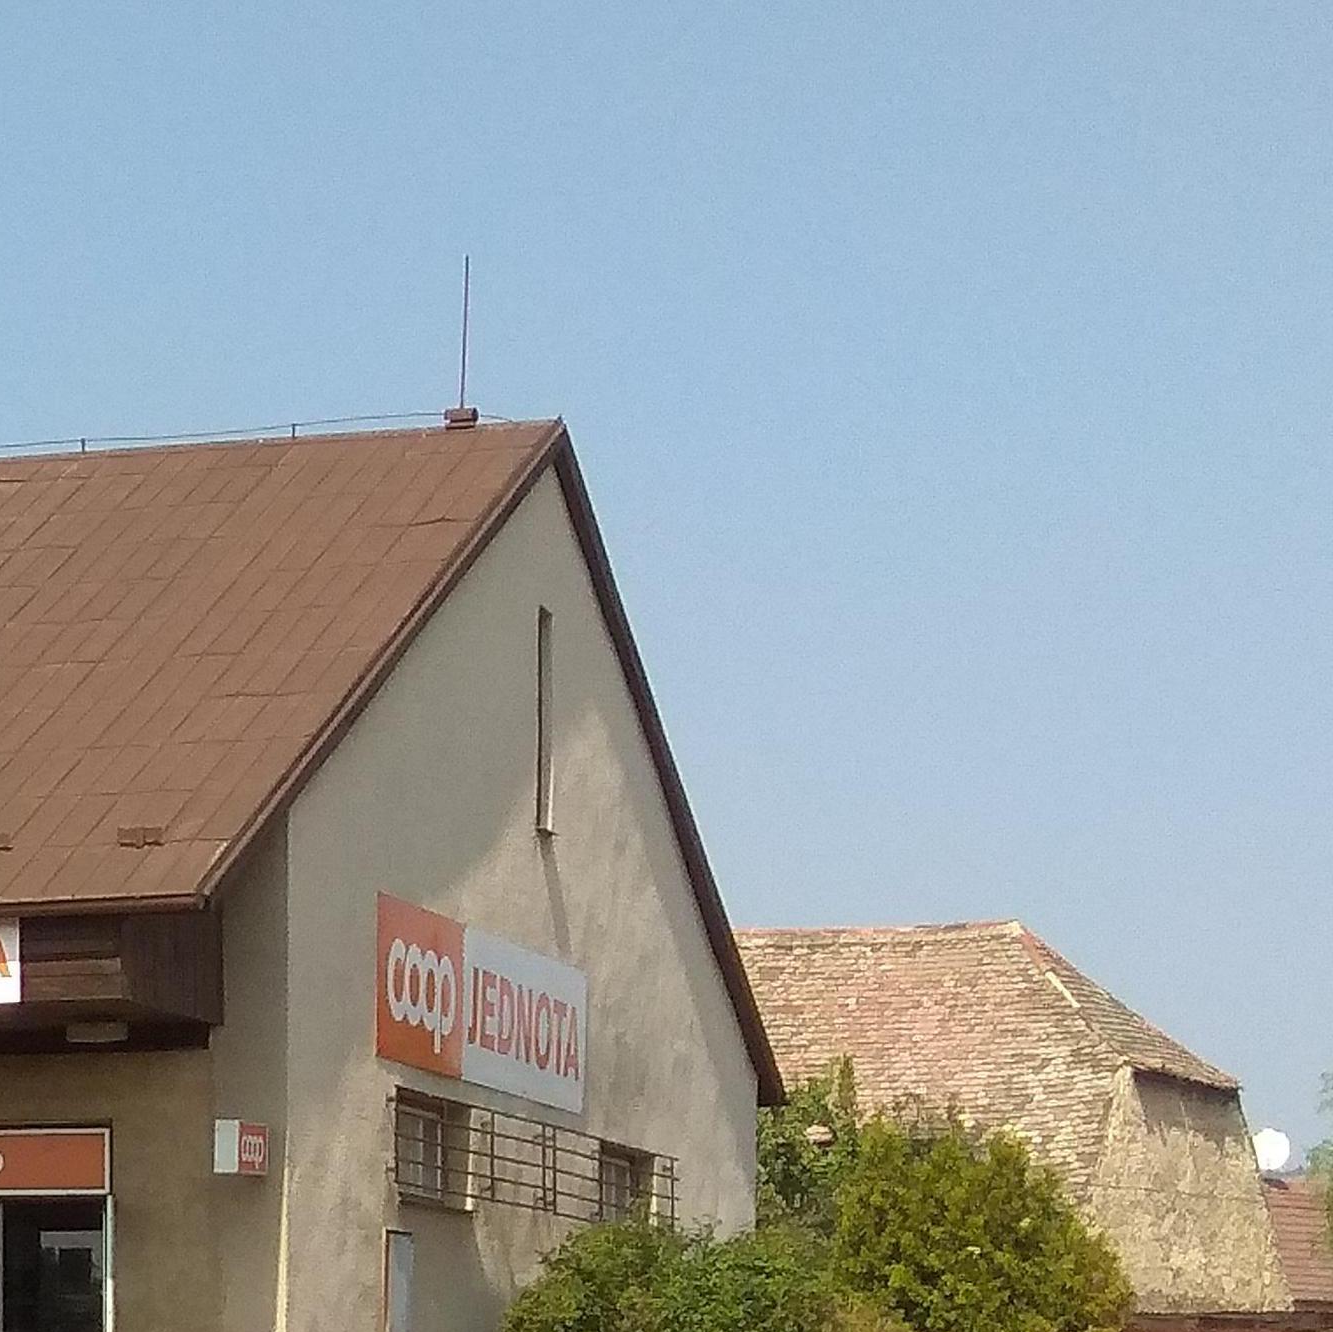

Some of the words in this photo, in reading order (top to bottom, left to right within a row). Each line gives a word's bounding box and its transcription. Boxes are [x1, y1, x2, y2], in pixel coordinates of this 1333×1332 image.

[387, 938, 456, 1055] coop
[467, 966, 580, 1081] JEDNOTA
[241, 1134, 264, 1169] coop
